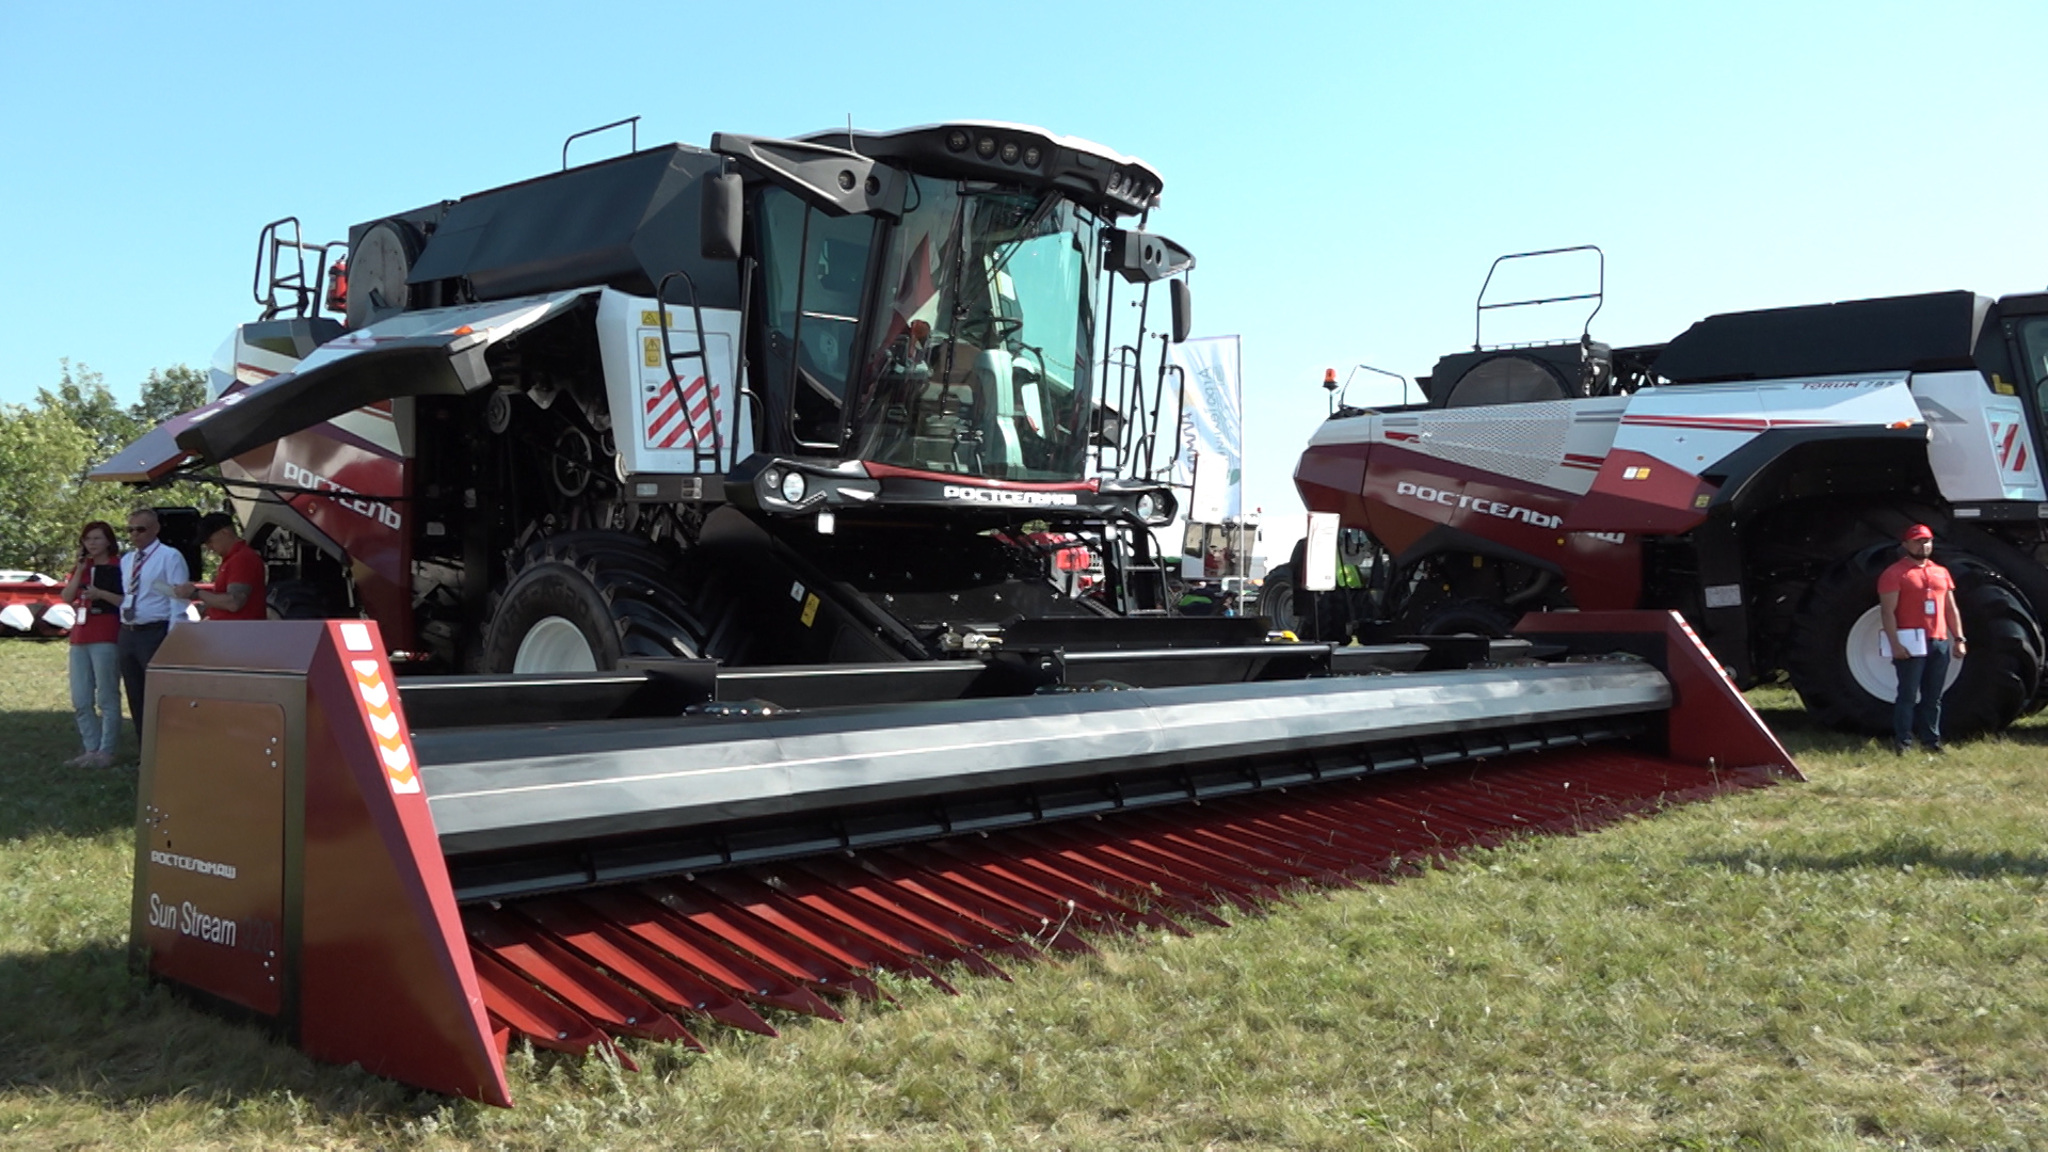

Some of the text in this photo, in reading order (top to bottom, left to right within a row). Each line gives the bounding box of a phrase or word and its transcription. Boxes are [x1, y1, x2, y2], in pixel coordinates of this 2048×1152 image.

[1801, 380, 1861, 391] TORUM
[150, 850, 237, 880] РОСТСЕЛЬМАШ
[149, 892, 177, 931] Sun
[180, 900, 238, 948] Stream
